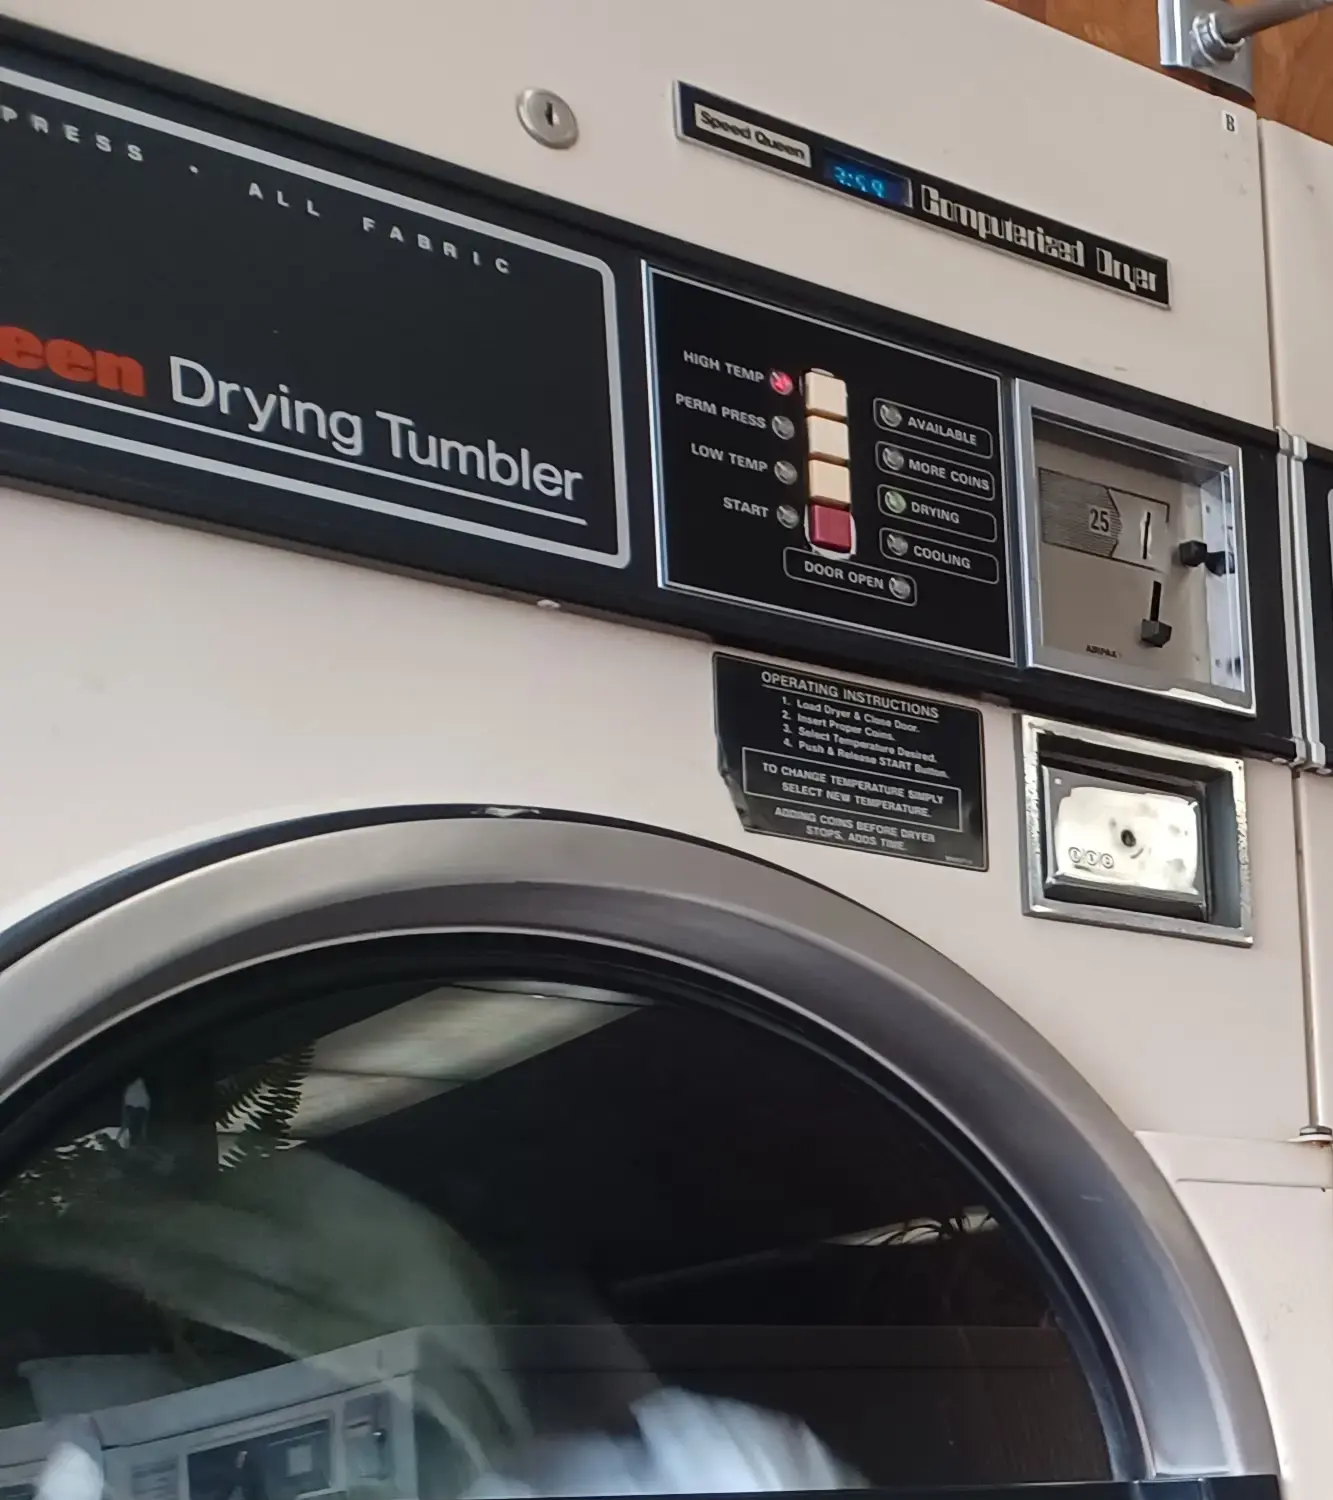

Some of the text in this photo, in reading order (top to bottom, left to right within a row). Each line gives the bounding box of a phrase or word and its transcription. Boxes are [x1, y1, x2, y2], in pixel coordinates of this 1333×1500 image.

[701, 110, 805, 160] Speed Queen
[1225, 113, 1235, 132] B
[0, 105, 511, 275] PRESS ALL FABRIC
[921, 184, 1157, 293] Computerized Dryer
[683, 350, 765, 384] HIGH TEMP
[676, 393, 767, 429] PERM PRESS
[169, 355, 363, 458] Drying
[376, 410, 583, 501] Tumbler
[907, 416, 977, 446] AVAILABLE
[691, 442, 769, 474] LOW TEMP
[908, 458, 990, 491] MORE COINS
[723, 496, 769, 519] START
[911, 501, 961, 524] DRYING
[1090, 508, 1110, 532] 25
[913, 545, 972, 570] COOLING
[804, 560, 884, 590] DOOR OPEN
[761, 671, 940, 719] OPERATING INSTRUCTIONS
[782, 696, 791, 705] 1.
[796, 699, 822, 713] Load
[824, 704, 851, 720] Dryer
[853, 711, 861, 721] &
[782, 710, 792, 720] 2.
[797, 713, 827, 728] Insert
[829, 719, 862, 735] Proper
[783, 723, 792, 733] 3.
[798, 726, 830, 742] Select
[833, 733, 895, 754] Temperature
[783, 737, 793, 748] 4.
[798, 740, 825, 755] Push
[837, 749, 877, 765] Release
[879, 756, 912, 772] START
[762, 762, 945, 805] TO CHANGE TEMPERATURE SIMPLY
[782, 782, 823, 797] SELECT
[826, 790, 852, 803] NEW
[774, 806, 936, 843] ADDING COINS BEFORE DRYER
[848, 832, 877, 846] ADDS
